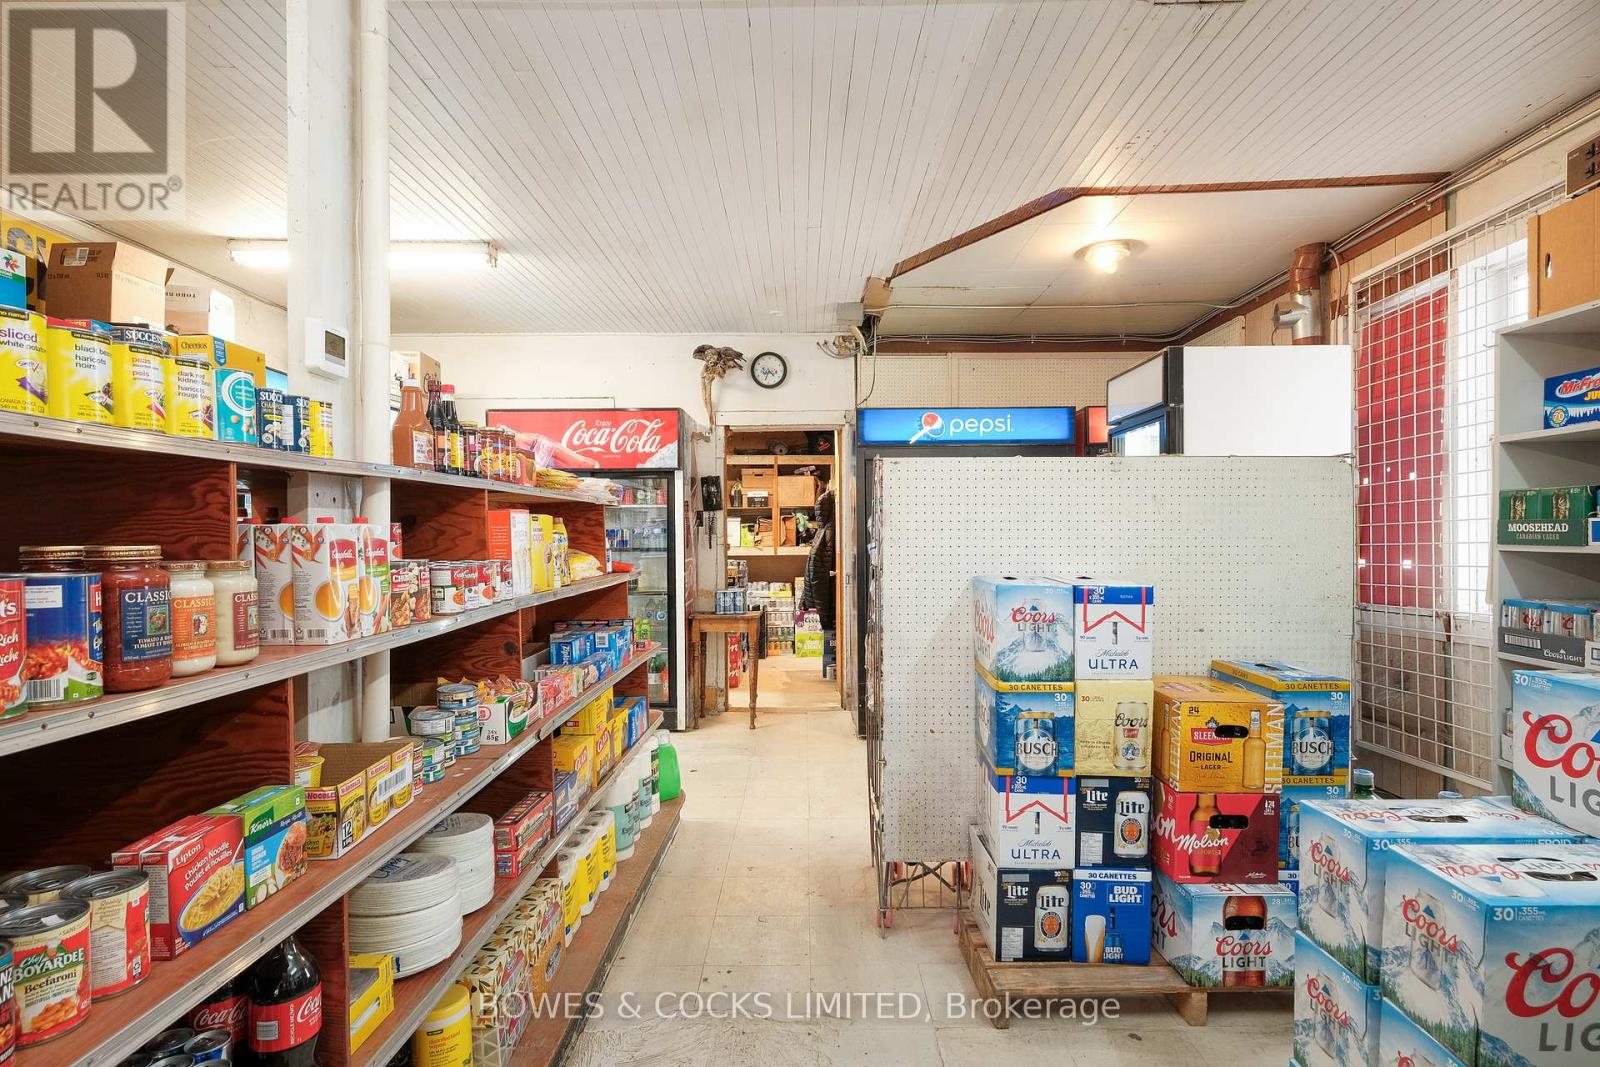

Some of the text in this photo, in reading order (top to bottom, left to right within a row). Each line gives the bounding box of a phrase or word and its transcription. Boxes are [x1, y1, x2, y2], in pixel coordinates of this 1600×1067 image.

[0, 328, 37, 343] sliced
[0, 340, 24, 349] white
[132, 370, 150, 378] pois
[595, 420, 611, 428] Enjoy
[949, 415, 1013, 436] pepsi
[562, 418, 665, 453] Coca-Cola
[1508, 522, 1569, 532] MOOSEHEAD
[125, 590, 173, 603] CLASSIC
[1094, 586, 1105, 595] 30
[174, 598, 215, 609] CLASSIC
[234, 593, 257, 603] CLASS
[1011, 607, 1057, 624] Coors
[1018, 622, 1057, 633] LIGHT
[1088, 658, 1139, 669] ULTRA
[1297, 682, 1340, 690] CANETTES
[1515, 674, 1528, 686] 30
[1054, 693, 1066, 701] 30
[1330, 692, 1343, 700] 30
[1189, 706, 1200, 714] 24
[1115, 713, 1149, 728] Coors
[1016, 741, 1058, 756] BUSCH
[1292, 741, 1335, 756] BUSCH
[1190, 751, 1233, 763] ORIGINAL
[1016, 776, 1027, 784] 30
[1293, 776, 1335, 784] CANETTES
[1086, 790, 1109, 803] Lite
[1326, 787, 1339, 795] 30
[1550, 775, 1600, 816] LIG
[1119, 801, 1145, 817] Lite
[250, 818, 273, 835] Knorr
[342, 821, 352, 838] 12
[1177, 835, 1229, 855] Molson
[1372, 838, 1390, 850] 30
[175, 843, 201, 865] Lipton
[1011, 849, 1061, 860] ULTRA
[184, 841, 230, 881] Chicken Noodle
[1311, 840, 1350, 882] Coors
[184, 869, 205, 891] Poulet
[210, 849, 233, 867] nouilles
[1007, 884, 1029, 898] Lite
[1113, 886, 1138, 894] BUD
[1451, 889, 1464, 902] 30
[1040, 896, 1065, 910] Lite
[1109, 894, 1142, 903] LIGHT
[1152, 895, 1178, 938] ors
[1493, 908, 1514, 921] 30
[1402, 894, 1458, 954] Coors
[1216, 935, 1273, 956] Coors
[14, 947, 85, 982] BOYARDEE
[20, 953, 45, 970] Chef
[1222, 957, 1266, 967] LIGHT
[24, 969, 77, 994] Beefaroni
[1307, 977, 1348, 1026] Coors
[1539, 1022, 1600, 1053] LIG
